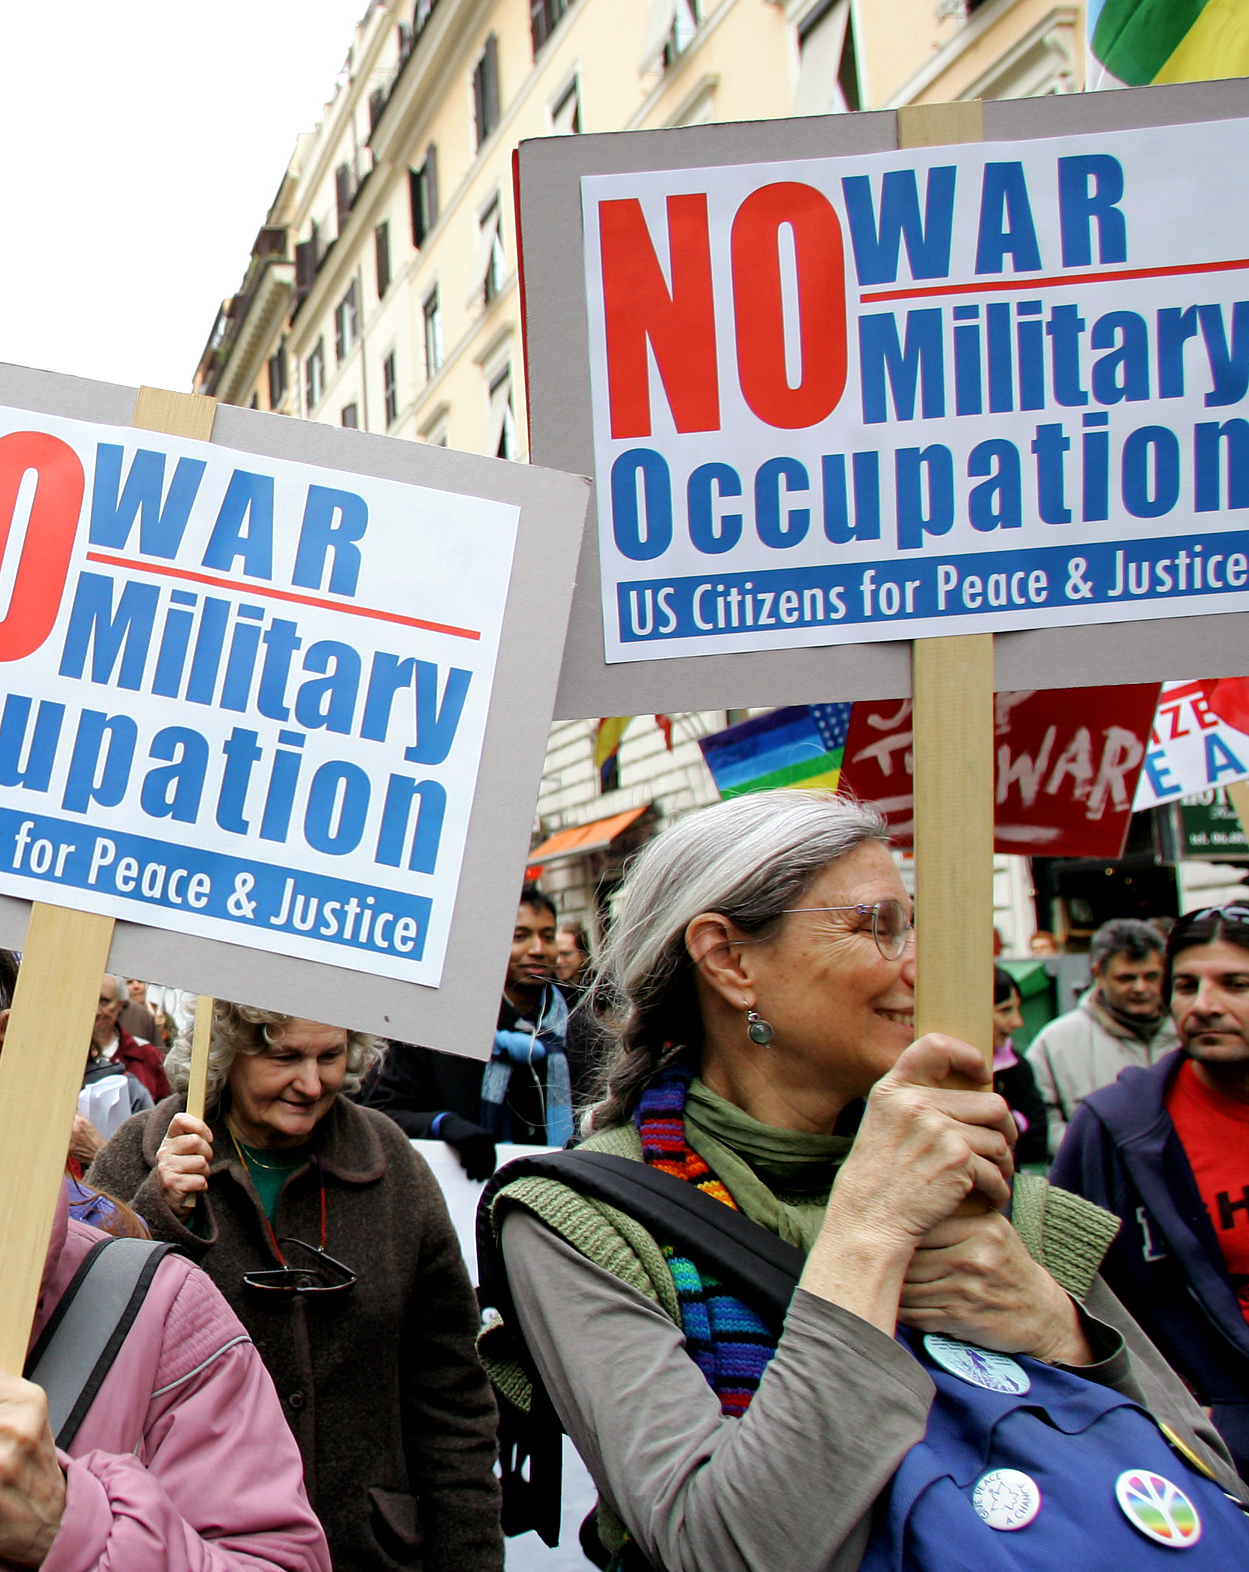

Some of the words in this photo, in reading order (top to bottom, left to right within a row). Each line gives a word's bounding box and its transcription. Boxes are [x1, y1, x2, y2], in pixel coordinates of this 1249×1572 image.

[841, 153, 1128, 287] WAR
[598, 180, 848, 439] NO
[858, 299, 1249, 425] Military
[88, 442, 369, 598] WAR
[610, 411, 1249, 561] Occupation
[630, 586, 677, 637] US
[692, 571, 847, 631] Citizens
[859, 568, 919, 617] for
[936, 564, 1048, 611] Peace
[1064, 556, 1092, 598] &
[1108, 545, 1249, 598] Justice
[59, 571, 472, 766] Military
[996, 725, 1144, 820] WAR
[12, 821, 76, 876] for
[88, 838, 213, 909] Peace
[226, 873, 259, 918] &
[271, 878, 418, 955] Justice
[974, 1471, 1002, 1496] PEACE
[1006, 1516, 1015, 1526] A
[1014, 1481, 1031, 1519] CHANCE
